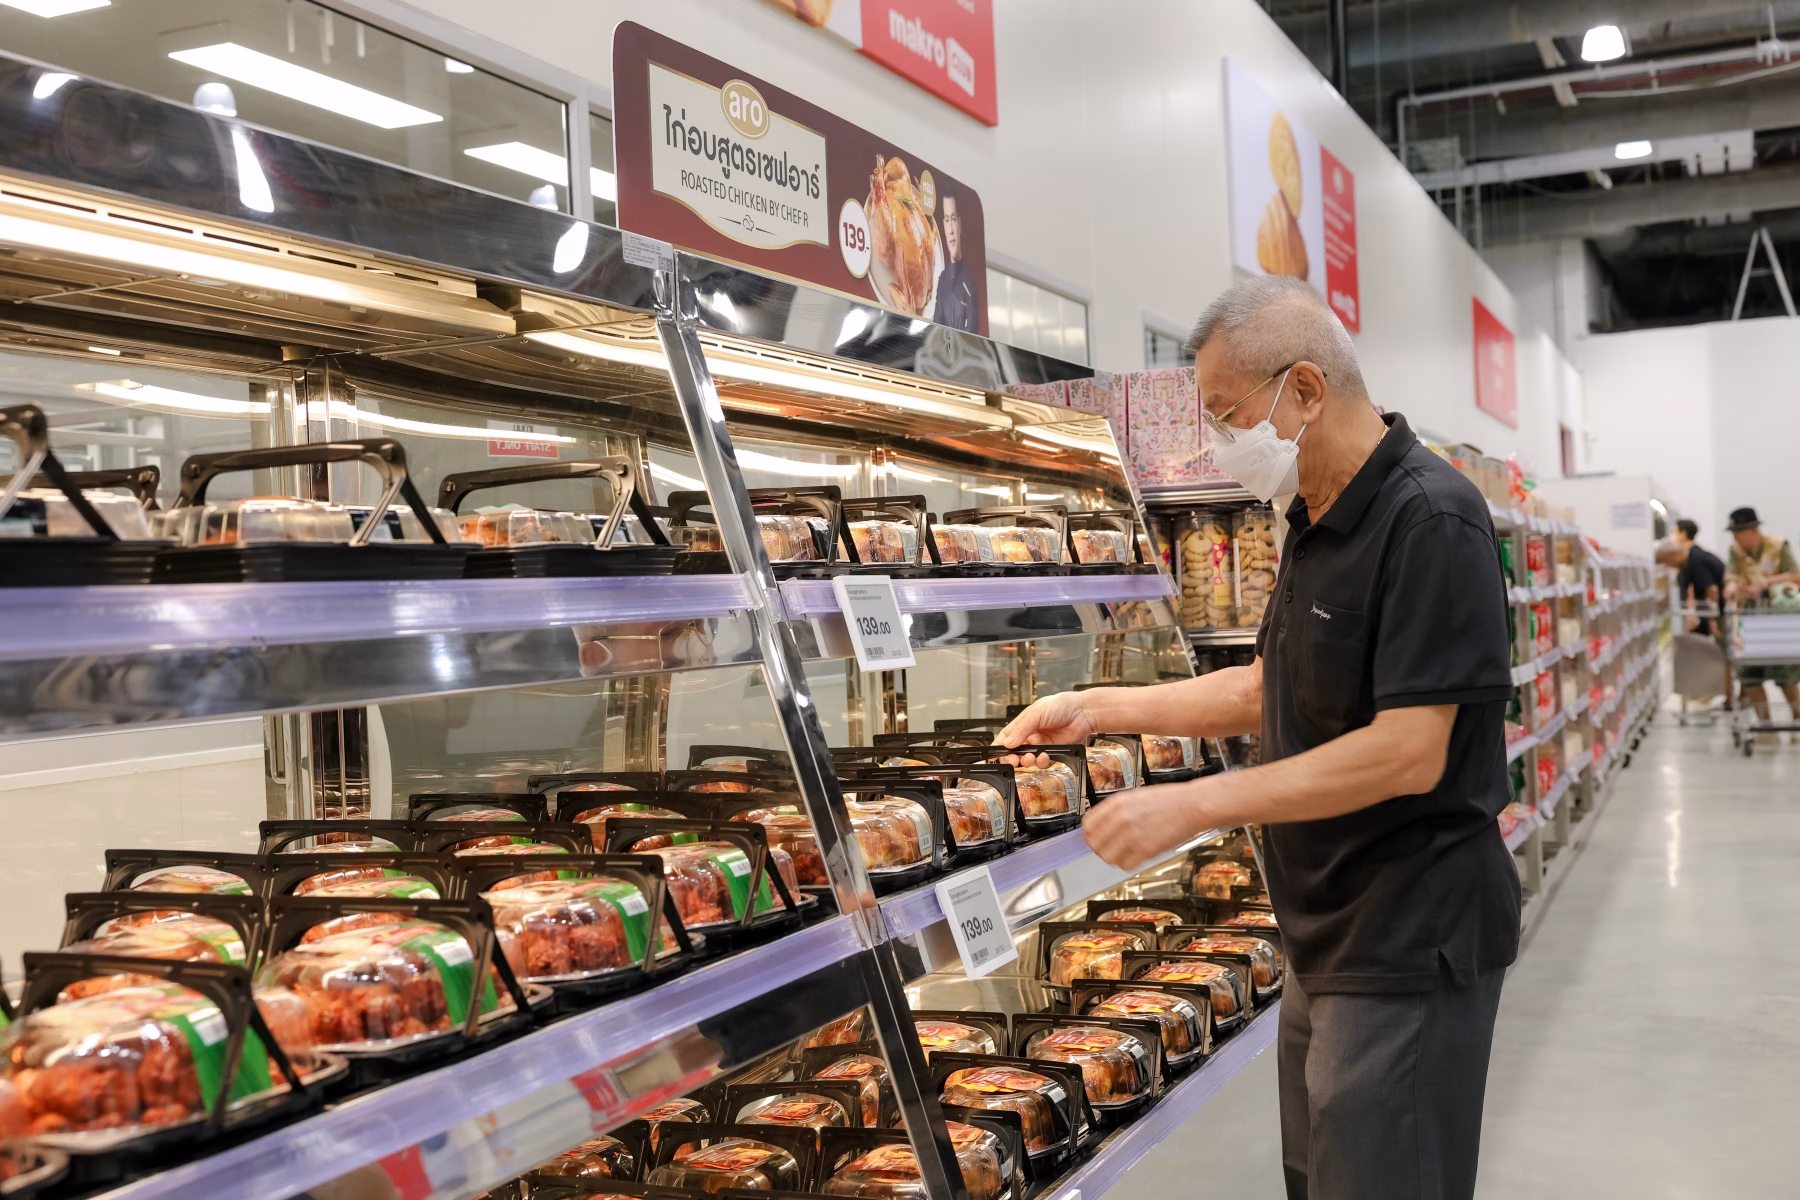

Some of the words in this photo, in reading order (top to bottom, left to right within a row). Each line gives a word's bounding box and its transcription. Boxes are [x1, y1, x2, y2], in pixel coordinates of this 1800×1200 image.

[888, 8, 945, 68] makro
[729, 90, 763, 127] aro
[663, 103, 820, 199] ไก่อบสูตรเชฟอาร์
[681, 169, 726, 200] ROASTED
[728, 186, 767, 213] CHICKEN
[769, 199, 779, 217] BY
[781, 204, 802, 224] CHEF
[803, 211, 809, 228] R
[856, 616, 891, 636] 139.00
[961, 916, 993, 941] 139.00
